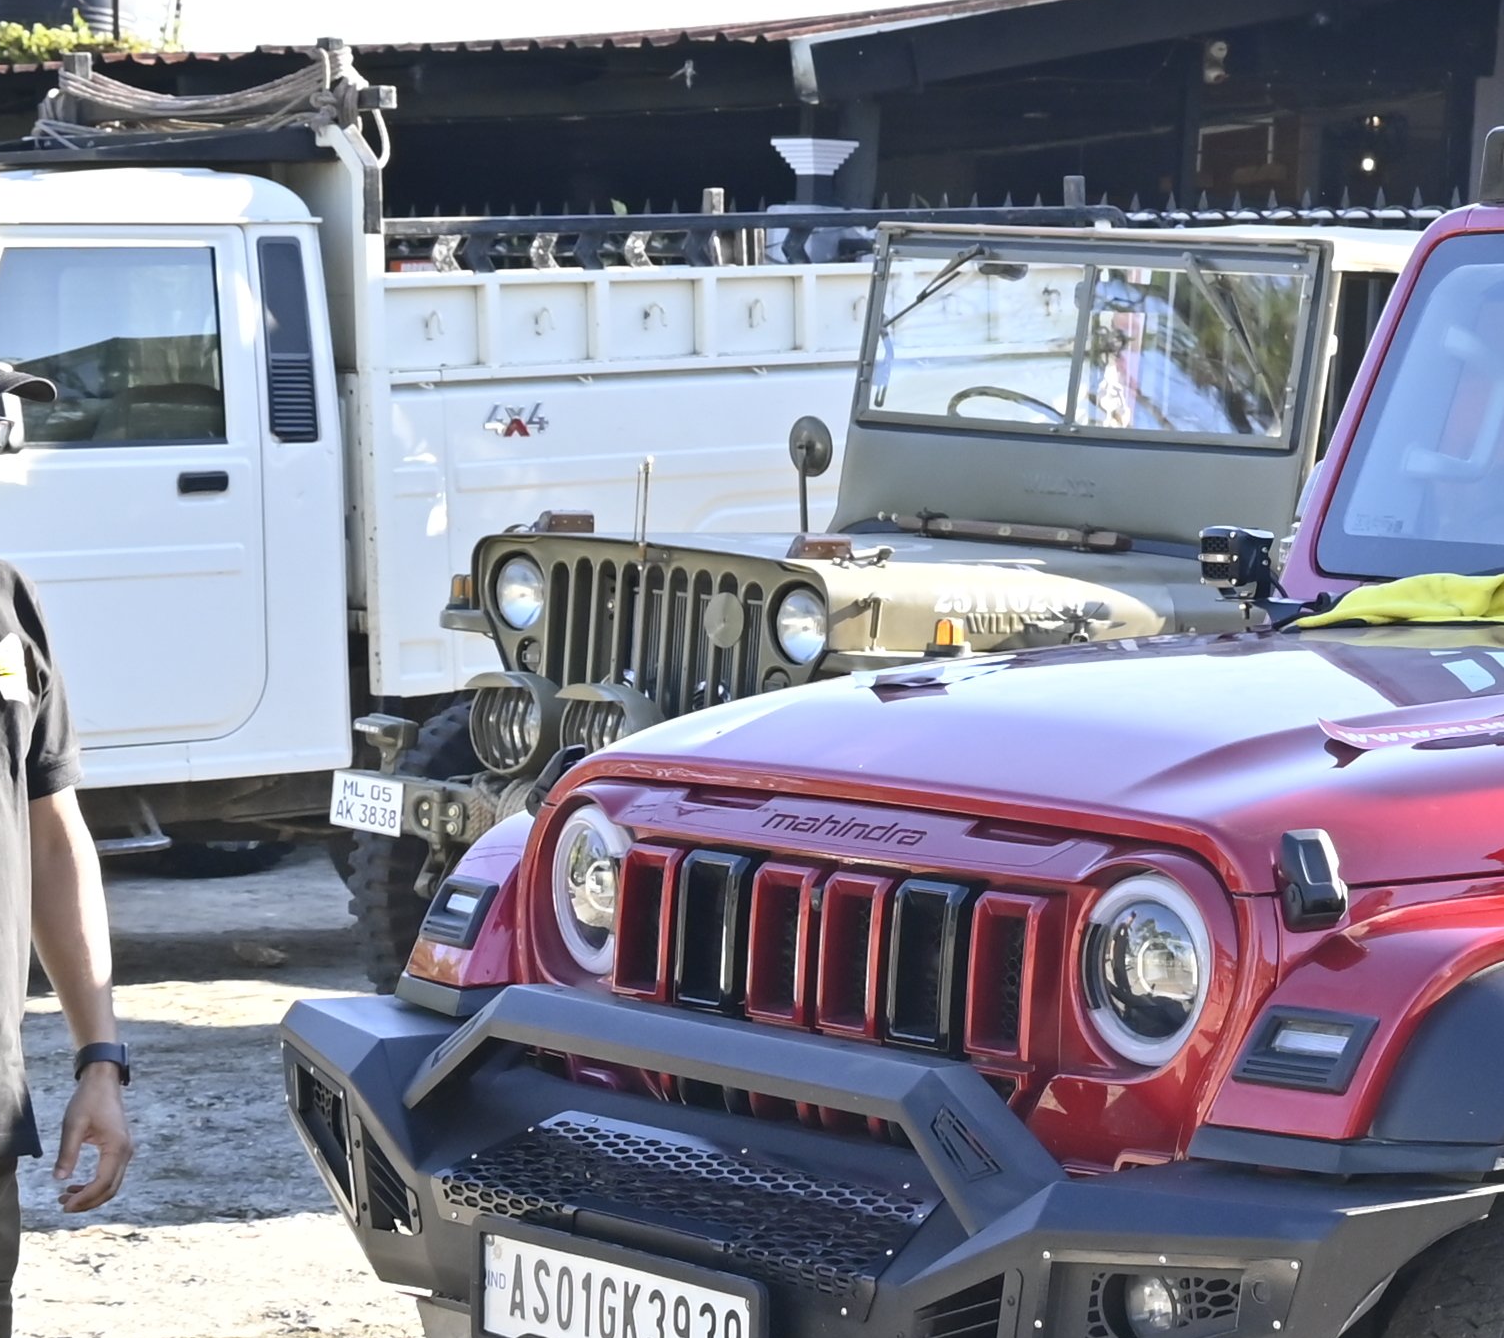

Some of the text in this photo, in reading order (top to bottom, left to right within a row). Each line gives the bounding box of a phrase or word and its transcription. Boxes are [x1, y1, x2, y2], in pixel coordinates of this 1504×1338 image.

[343, 779, 393, 803] ML 05
[336, 799, 397, 829] AK 3838
[761, 812, 928, 847] mahindra
[487, 1269, 507, 1291] IND
